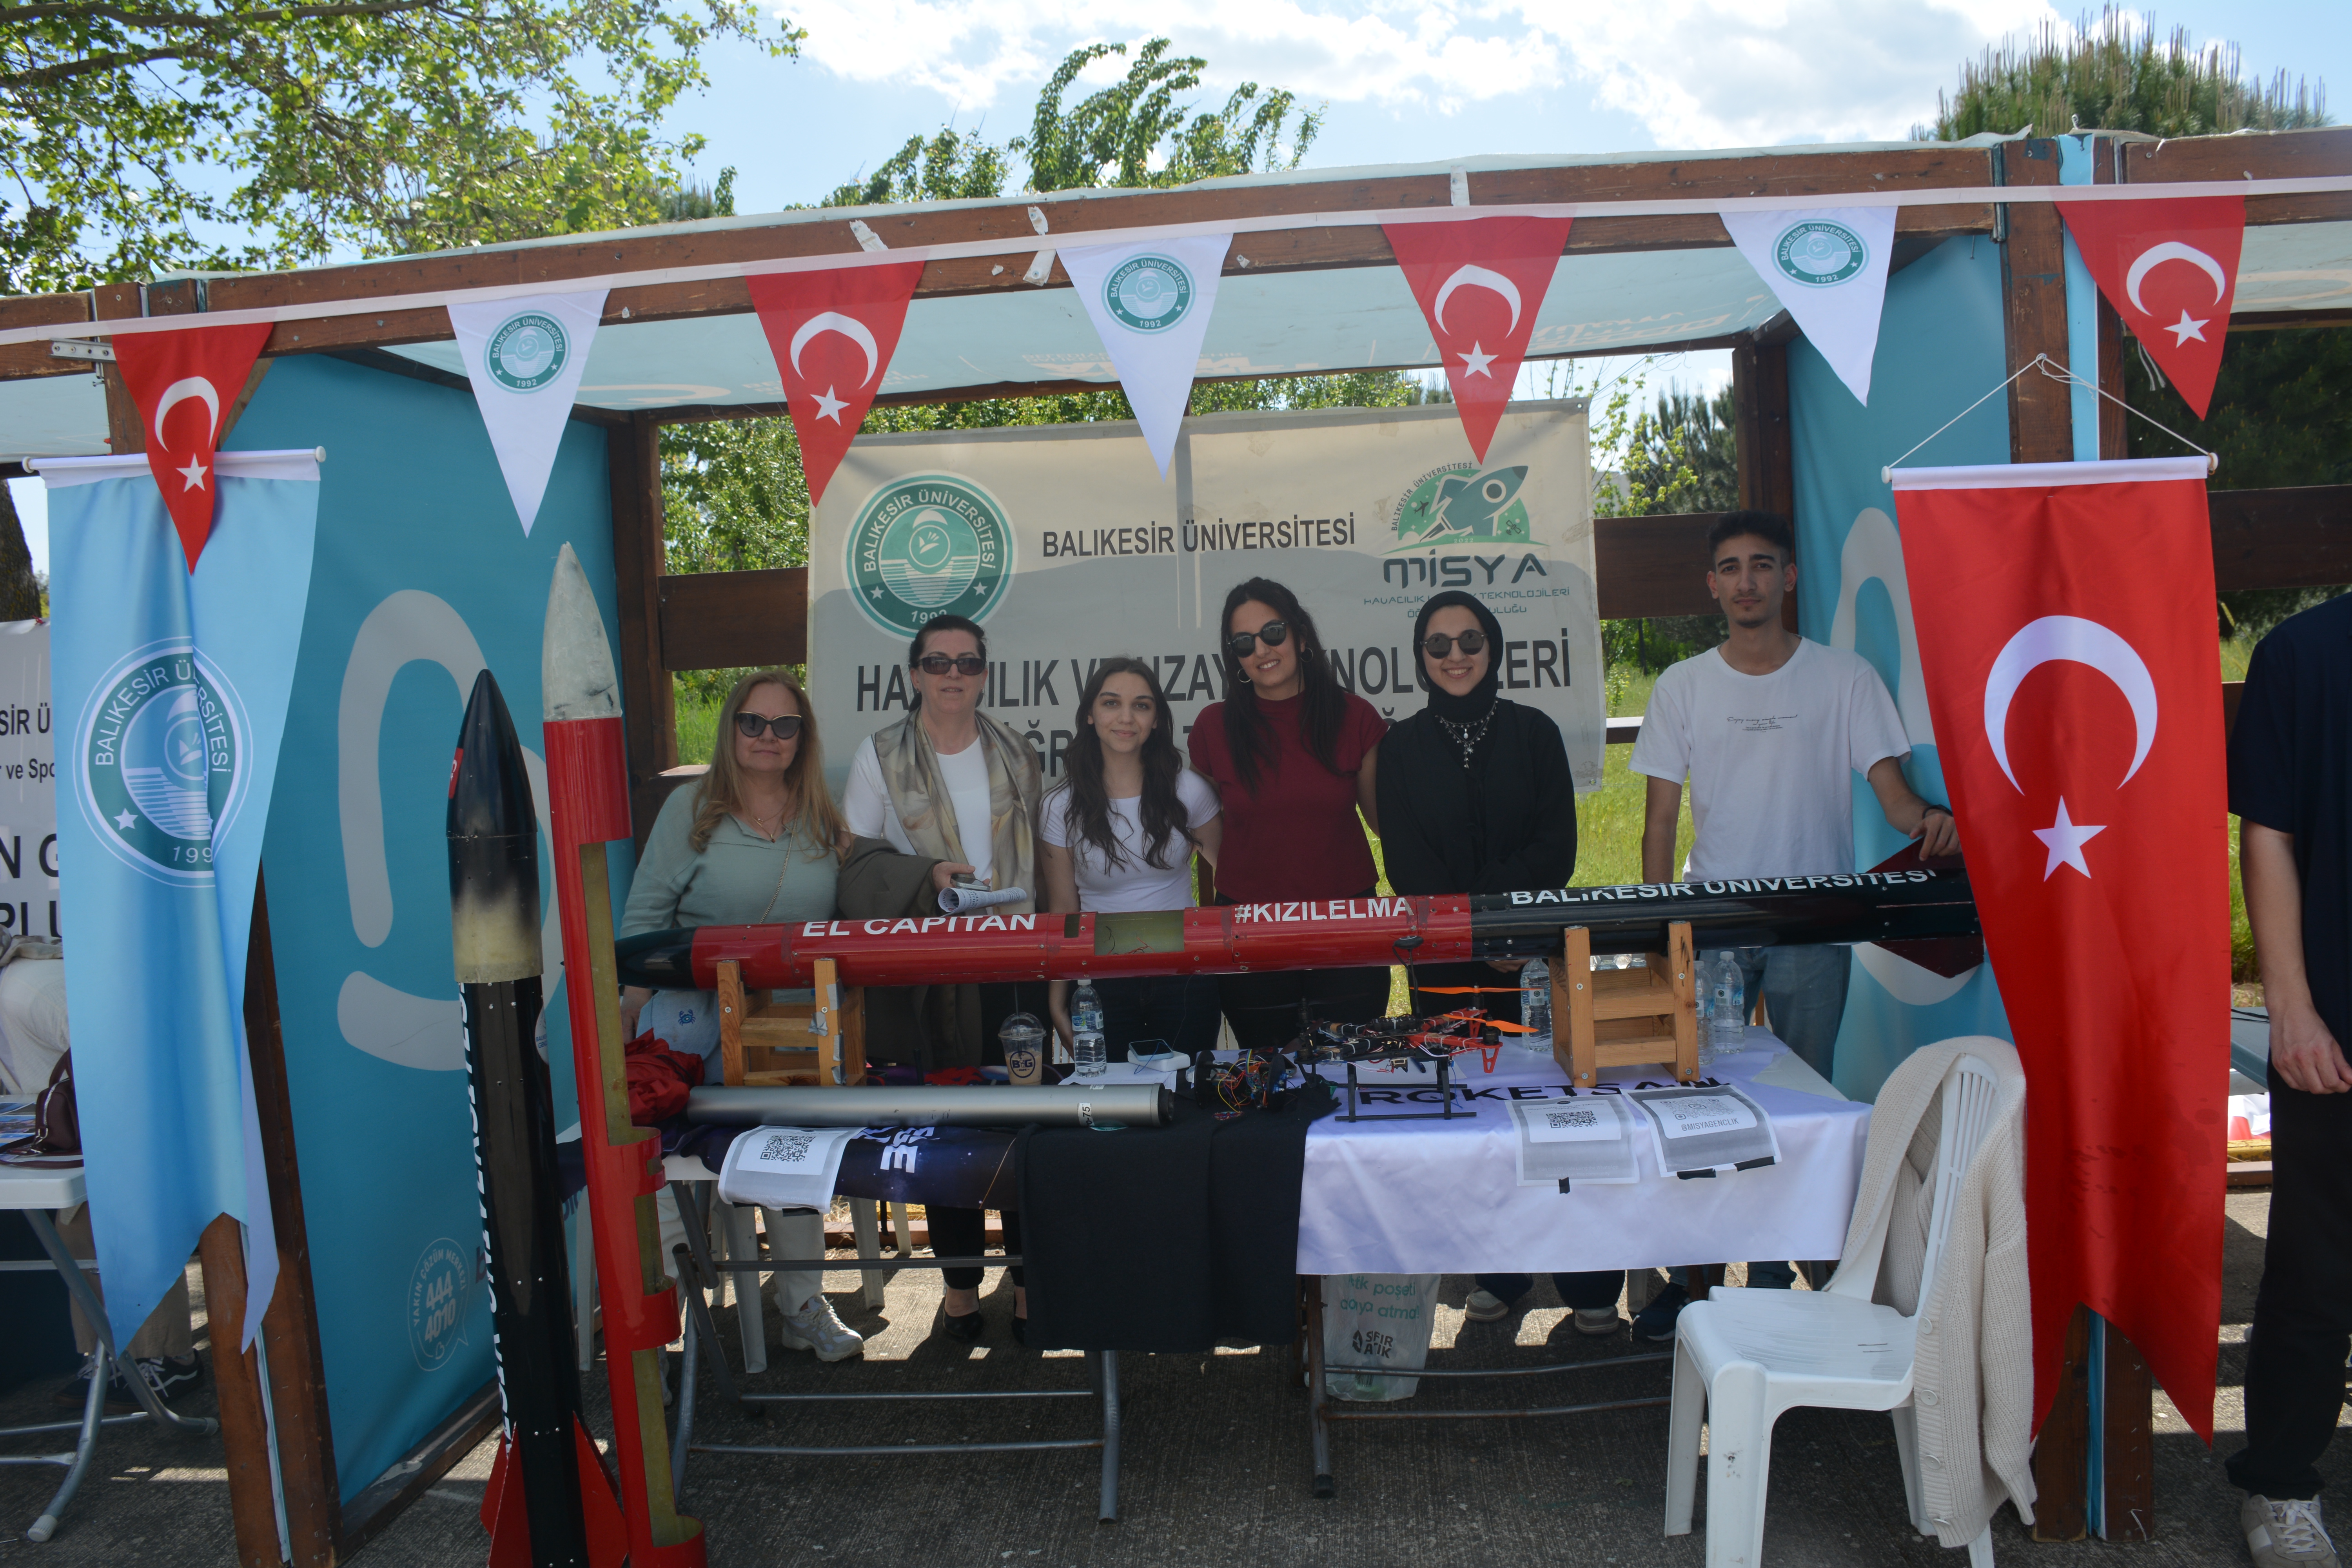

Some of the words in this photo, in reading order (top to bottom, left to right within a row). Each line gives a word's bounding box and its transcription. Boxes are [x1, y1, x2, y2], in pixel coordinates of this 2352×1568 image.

[1781, 227, 1807, 261] BALIKESİR
[1808, 225, 1861, 253] ÜNİVERSİTESİ
[1111, 263, 1139, 298] BALIKESİR
[1141, 260, 1188, 294] ÜNİVERSİTESİ
[1815, 274, 1838, 283] 1992
[492, 321, 521, 358] BALIKESİR
[523, 317, 564, 352] ÜNİVERSİTESİ
[517, 379, 537, 387] 1992
[1391, 488, 1414, 531] BALIKESİR
[1413, 462, 1473, 488] ÜNİVERSİTESİ
[864, 494, 914, 572] BALIKESİR
[918, 489, 996, 569] ÜNİVERSİTESİ
[1043, 521, 1175, 557] BALIKESİR
[1182, 512, 1355, 552] ÜNİVERSİTESİ
[95, 666, 169, 766] BALIKESİR
[6, 764, 24, 779] ve
[172, 846, 213, 863] 199
[1702, 869, 1936, 894] ÜNİVERSİTESİ
[802, 920, 850, 937] EL
[864, 914, 1036, 935] CAPITAN
[1234, 897, 1414, 924] #KIZILELMA
[1681, 1118, 1739, 1131] @MISYAGENCLIK
[413, 1282, 423, 1327] YAKIN
[420, 1248, 444, 1280] ÇÖZÜM
[426, 1270, 453, 1310] 444
[1373, 1282, 1416, 1300] poşeti
[425, 1298, 456, 1343] 4010
